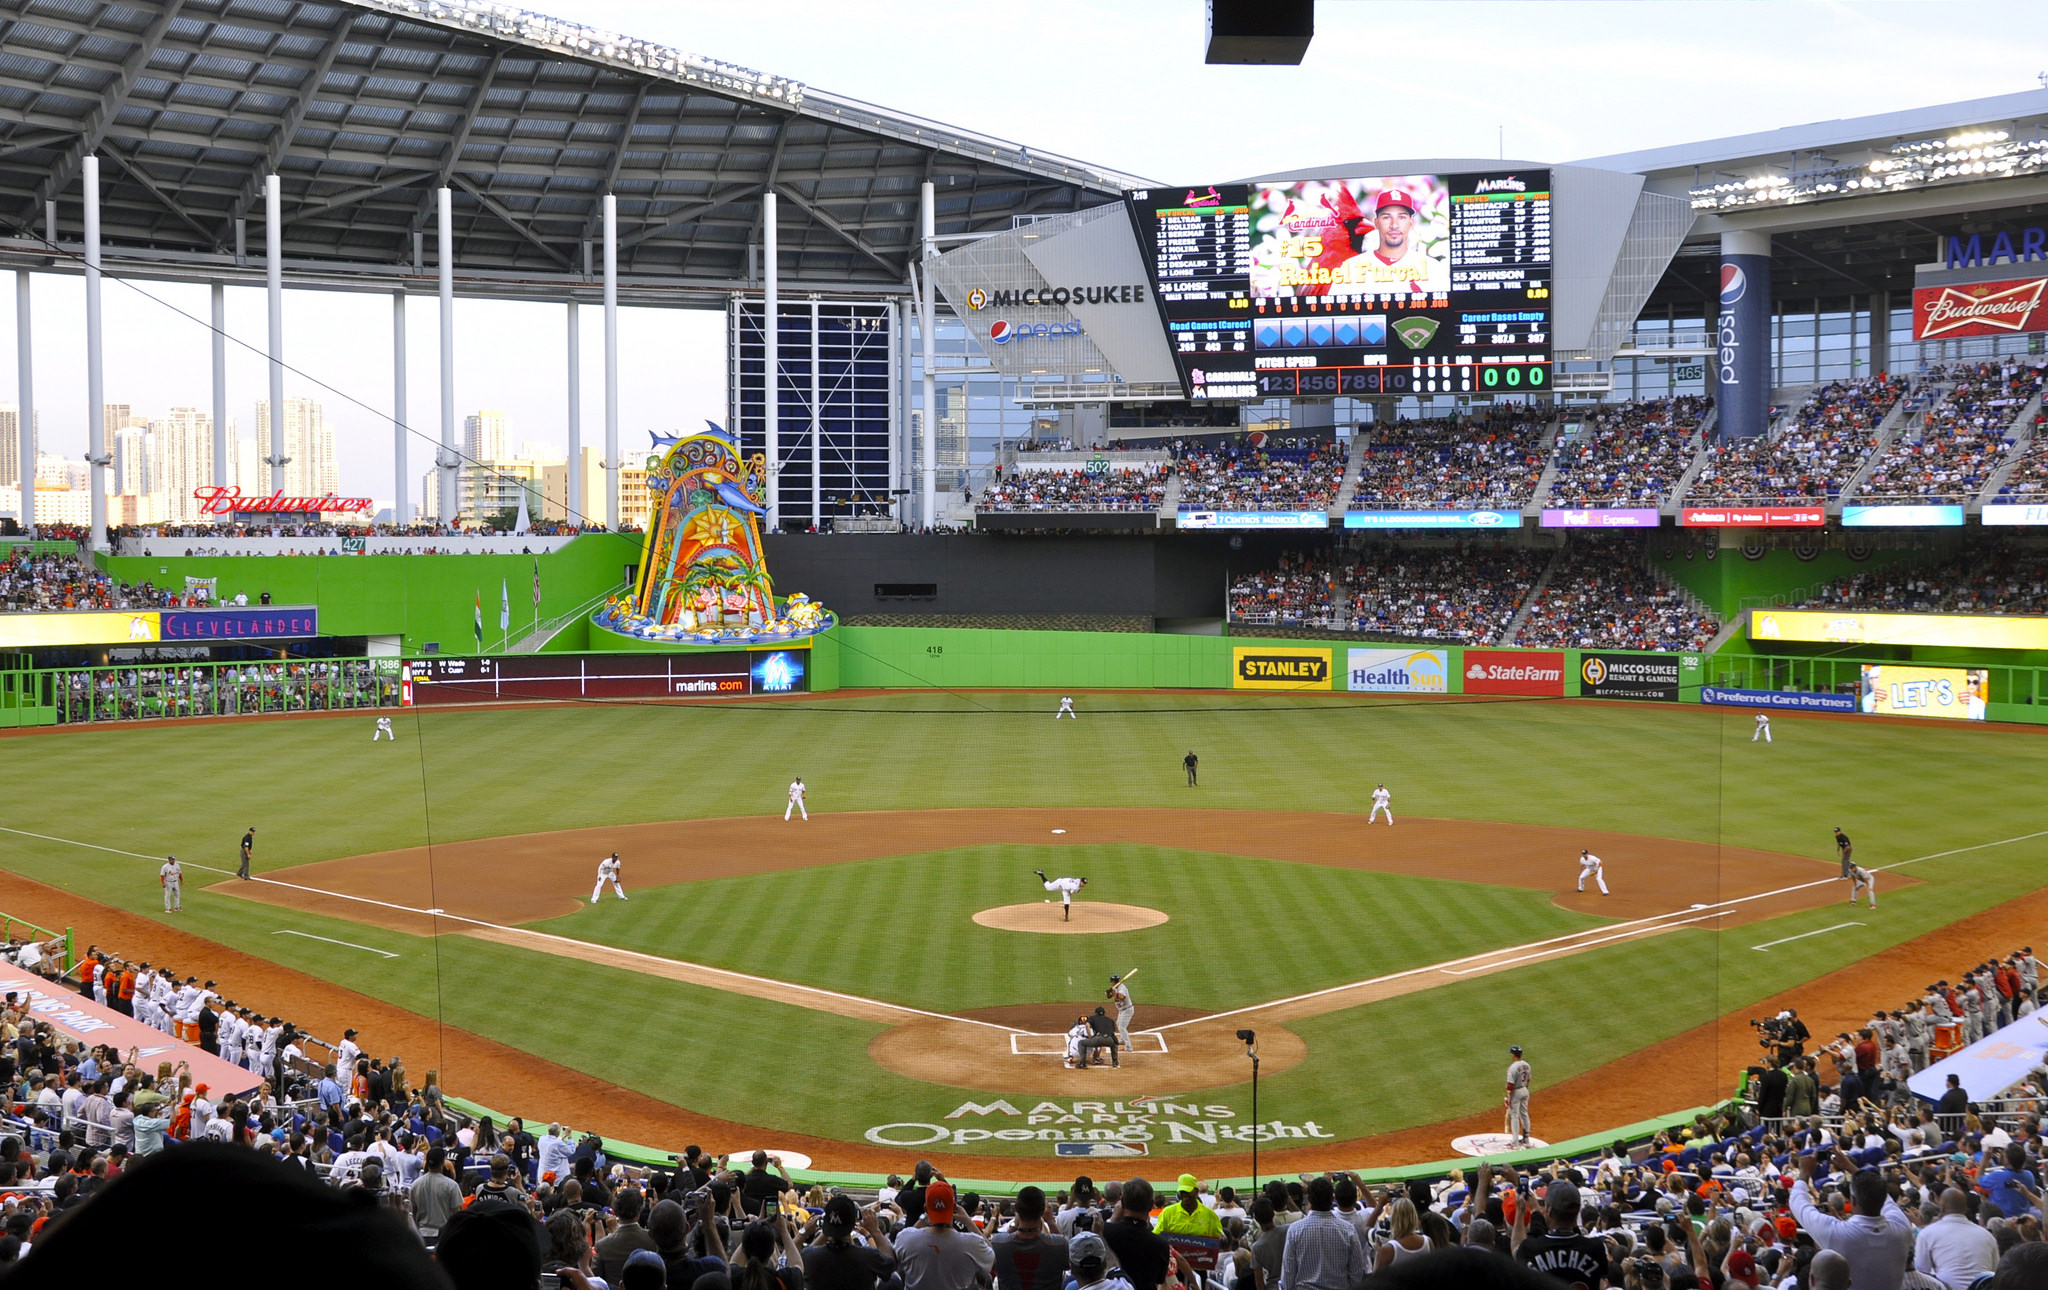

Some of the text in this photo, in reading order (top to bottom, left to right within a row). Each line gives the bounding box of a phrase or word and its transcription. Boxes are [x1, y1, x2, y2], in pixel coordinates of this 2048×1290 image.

[1475, 176, 1525, 194] MARLINS
[1289, 216, 1337, 232] Cardinals
[1280, 236, 1324, 258] #15
[1947, 227, 2048, 269] MAR
[1280, 260, 1428, 286] Rafael Furcal
[1453, 271, 1524, 281] 55 JOHNSON
[1159, 282, 1208, 292] 26 LOHSE
[1527, 288, 1548, 298] 0.00
[993, 285, 1144, 307] MICCOSUKEE
[1229, 299, 1249, 308] 0.00
[1924, 297, 2040, 322] Budweiser
[1462, 312, 1544, 322] Career Bases Empty
[1017, 319, 1080, 342] pepsi
[1170, 322, 1190, 330] Road
[1191, 321, 1217, 330] Games
[1721, 308, 1739, 384] pepsi
[1205, 372, 1257, 382] CARDINALS
[1484, 367, 1543, 386] 0 0 0
[1679, 367, 1701, 379] 465
[1207, 385, 1258, 397] MARLINS
[1087, 462, 1109, 472] 502
[194, 485, 373, 515] Budweiser
[1225, 516, 1260, 524] CENTROS
[1264, 515, 1297, 524] MÉDICOS
[1563, 511, 1635, 527] FedEx Express
[2025, 508, 2048, 520] FL
[343, 539, 365, 551] 427
[1230, 537, 1242, 546] 42
[166, 616, 311, 636] CLEVELANDER
[927, 646, 943, 654] 418
[382, 660, 399, 668] 386
[1682, 657, 1698, 666] 392
[1245, 661, 1321, 677] STANLEY
[1488, 665, 1559, 681] StateFarm
[1609, 664, 1677, 675] MICCOSUKEE
[1353, 668, 1442, 686] HealthSun
[1646, 675, 1677, 683] GAMING
[676, 680, 743, 692] marlins.com
[1717, 692, 1853, 708] Preferred Care Partners
[1891, 679, 1953, 709] LET'S
[944, 1094, 1235, 1121] MARLINS
[1027, 1113, 1157, 1125] PARK
[864, 1120, 1334, 1146] Opening Night
[1168, 1237, 1205, 1246] MIAMI
